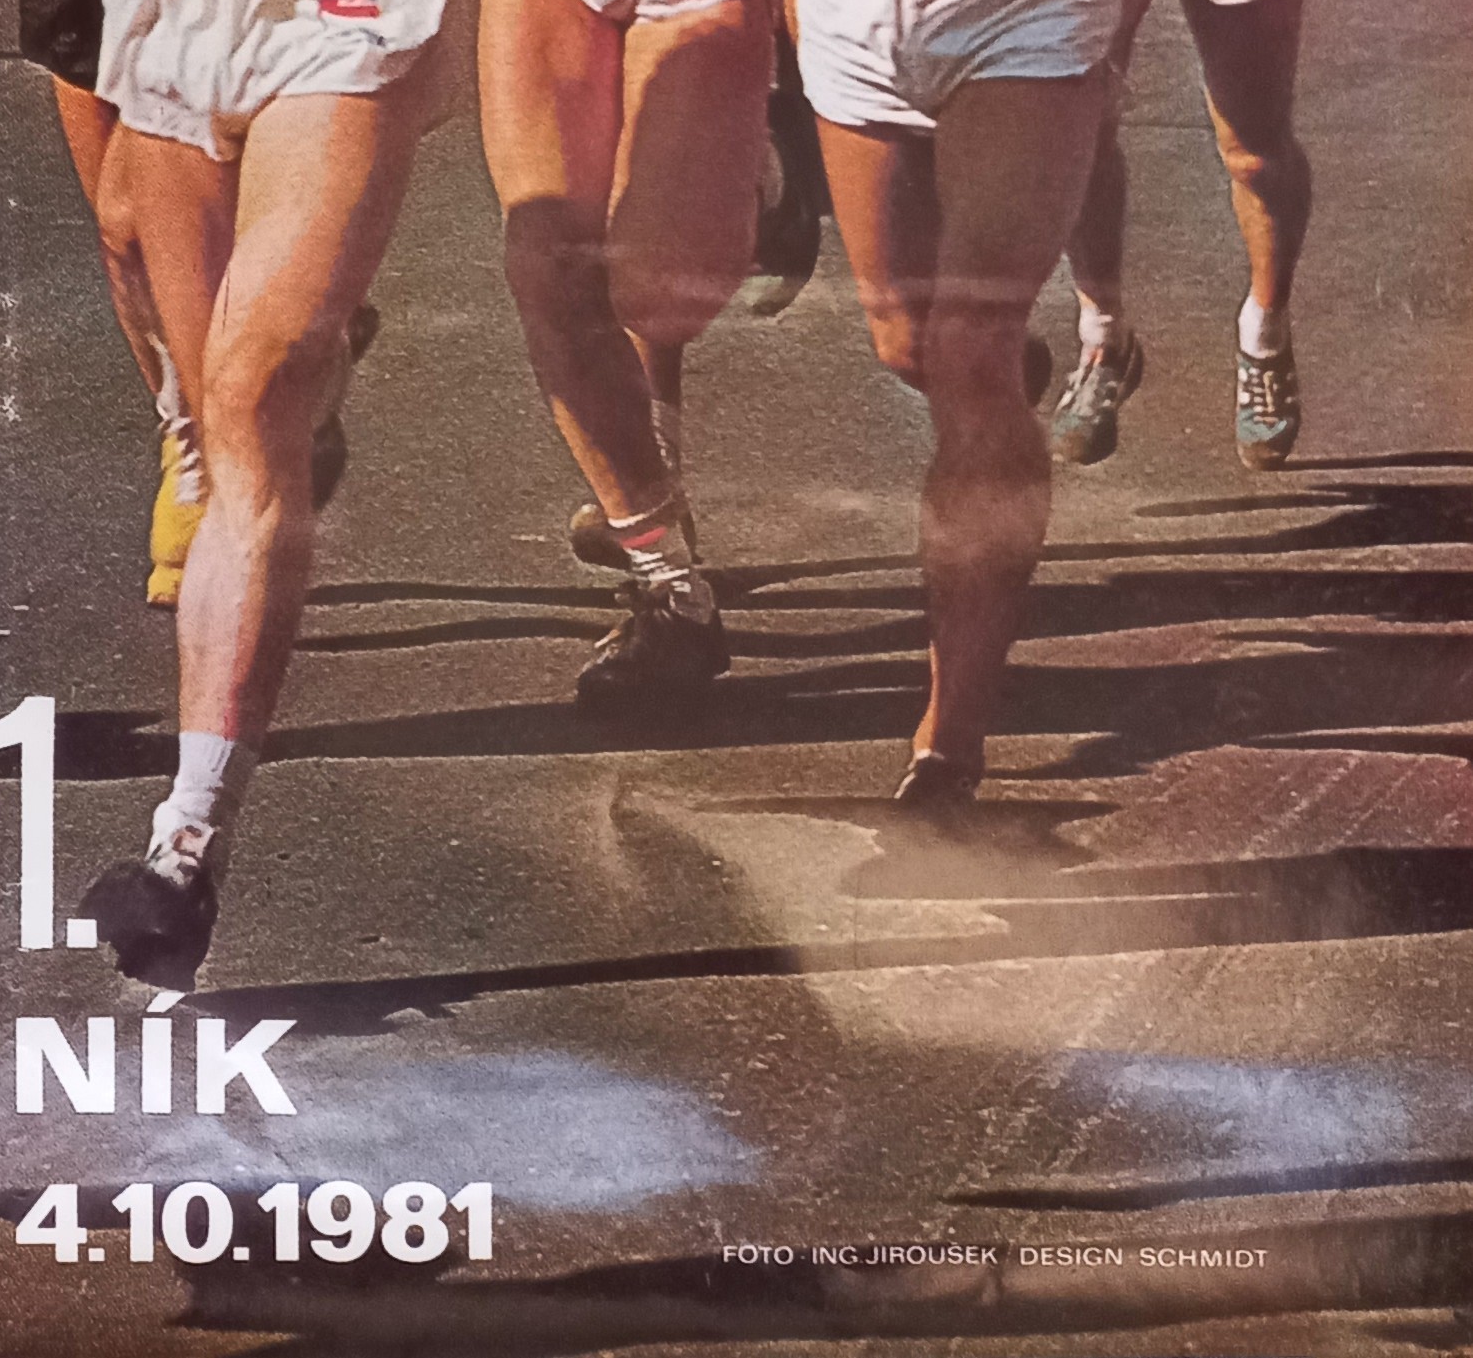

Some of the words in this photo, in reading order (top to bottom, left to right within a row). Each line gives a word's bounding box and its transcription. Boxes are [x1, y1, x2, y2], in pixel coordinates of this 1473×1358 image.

[15, 1181, 494, 1264] 4.10.1981
[723, 1244, 794, 1266] FOTO
[1019, 1246, 1124, 1267] DESIGN
[1139, 1246, 1269, 1268] SCHMIDT
